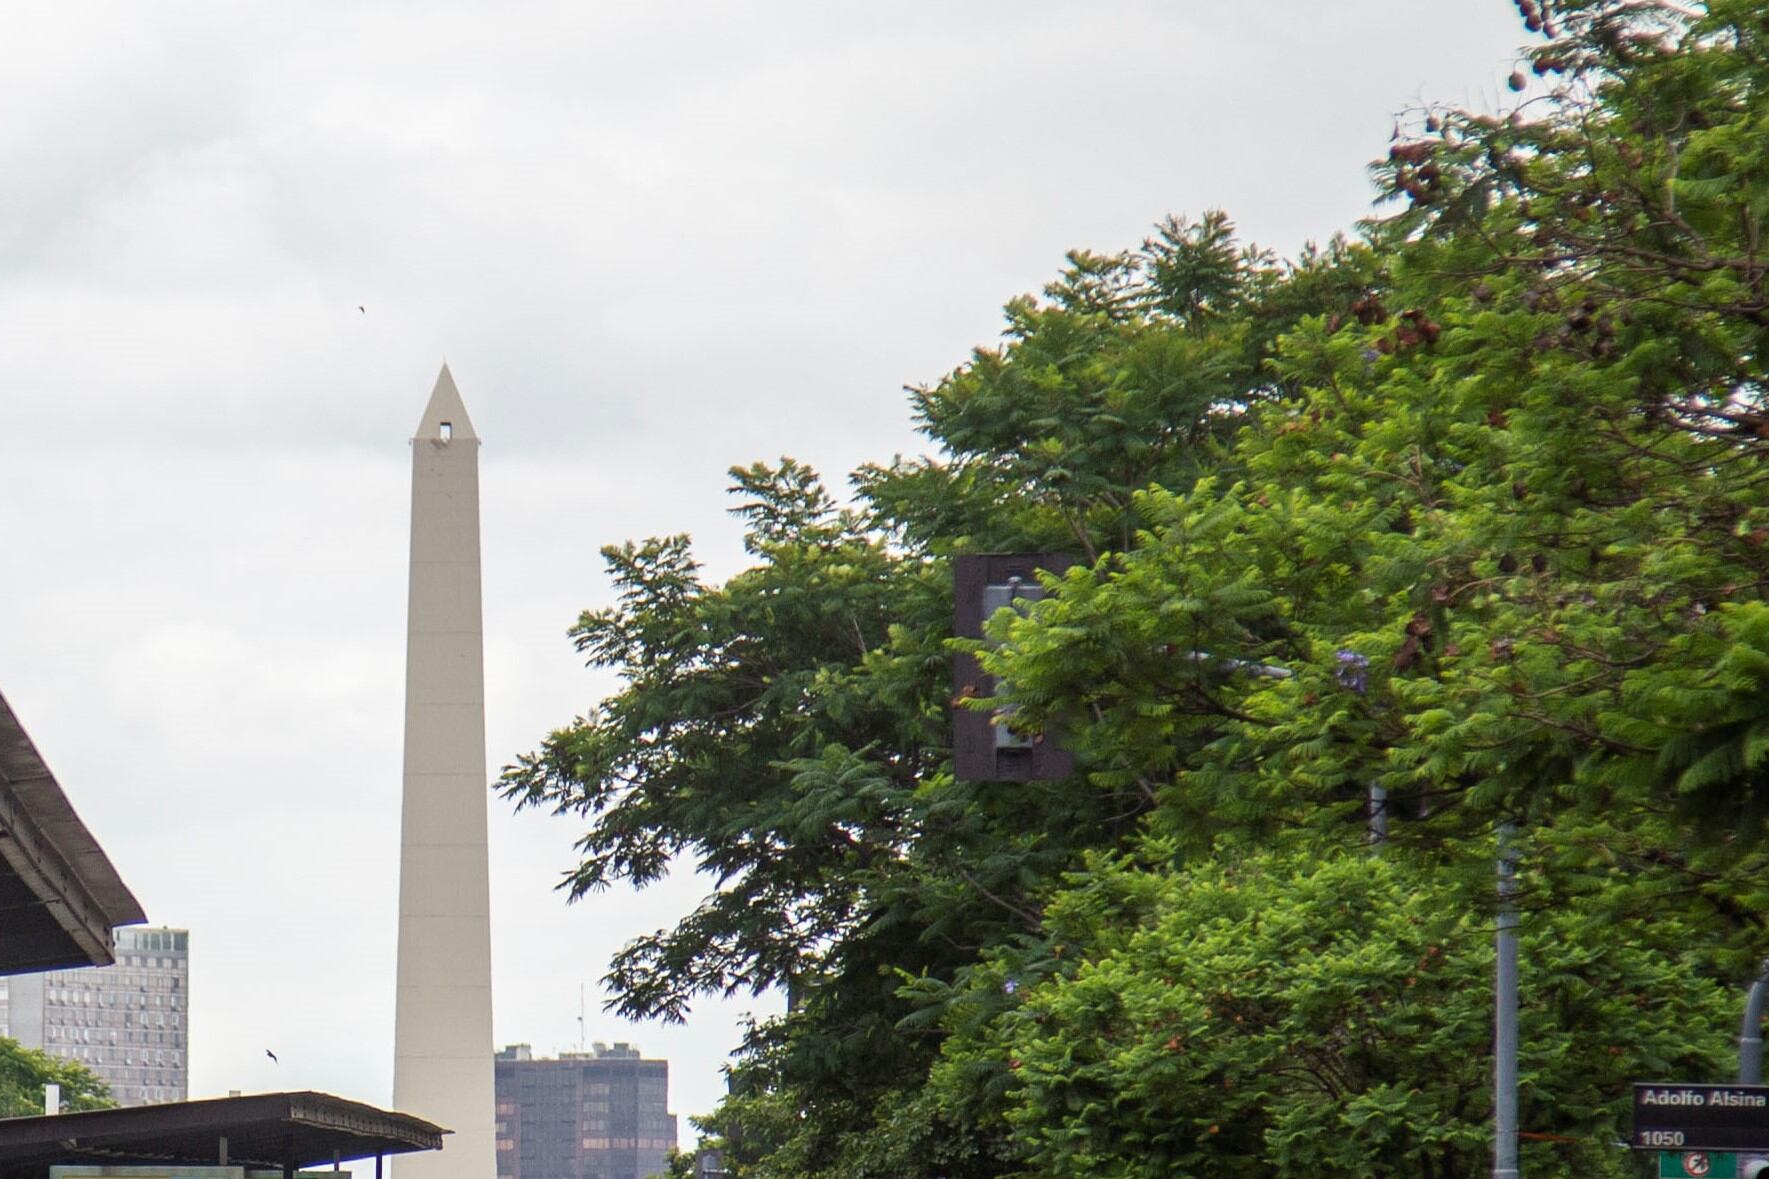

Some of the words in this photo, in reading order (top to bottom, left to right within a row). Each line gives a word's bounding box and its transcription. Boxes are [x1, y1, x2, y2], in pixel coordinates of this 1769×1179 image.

[1643, 1089, 1705, 1106] Adolfo
[1710, 1091, 1767, 1107] Alsina
[1641, 1131, 1685, 1146] 1050
